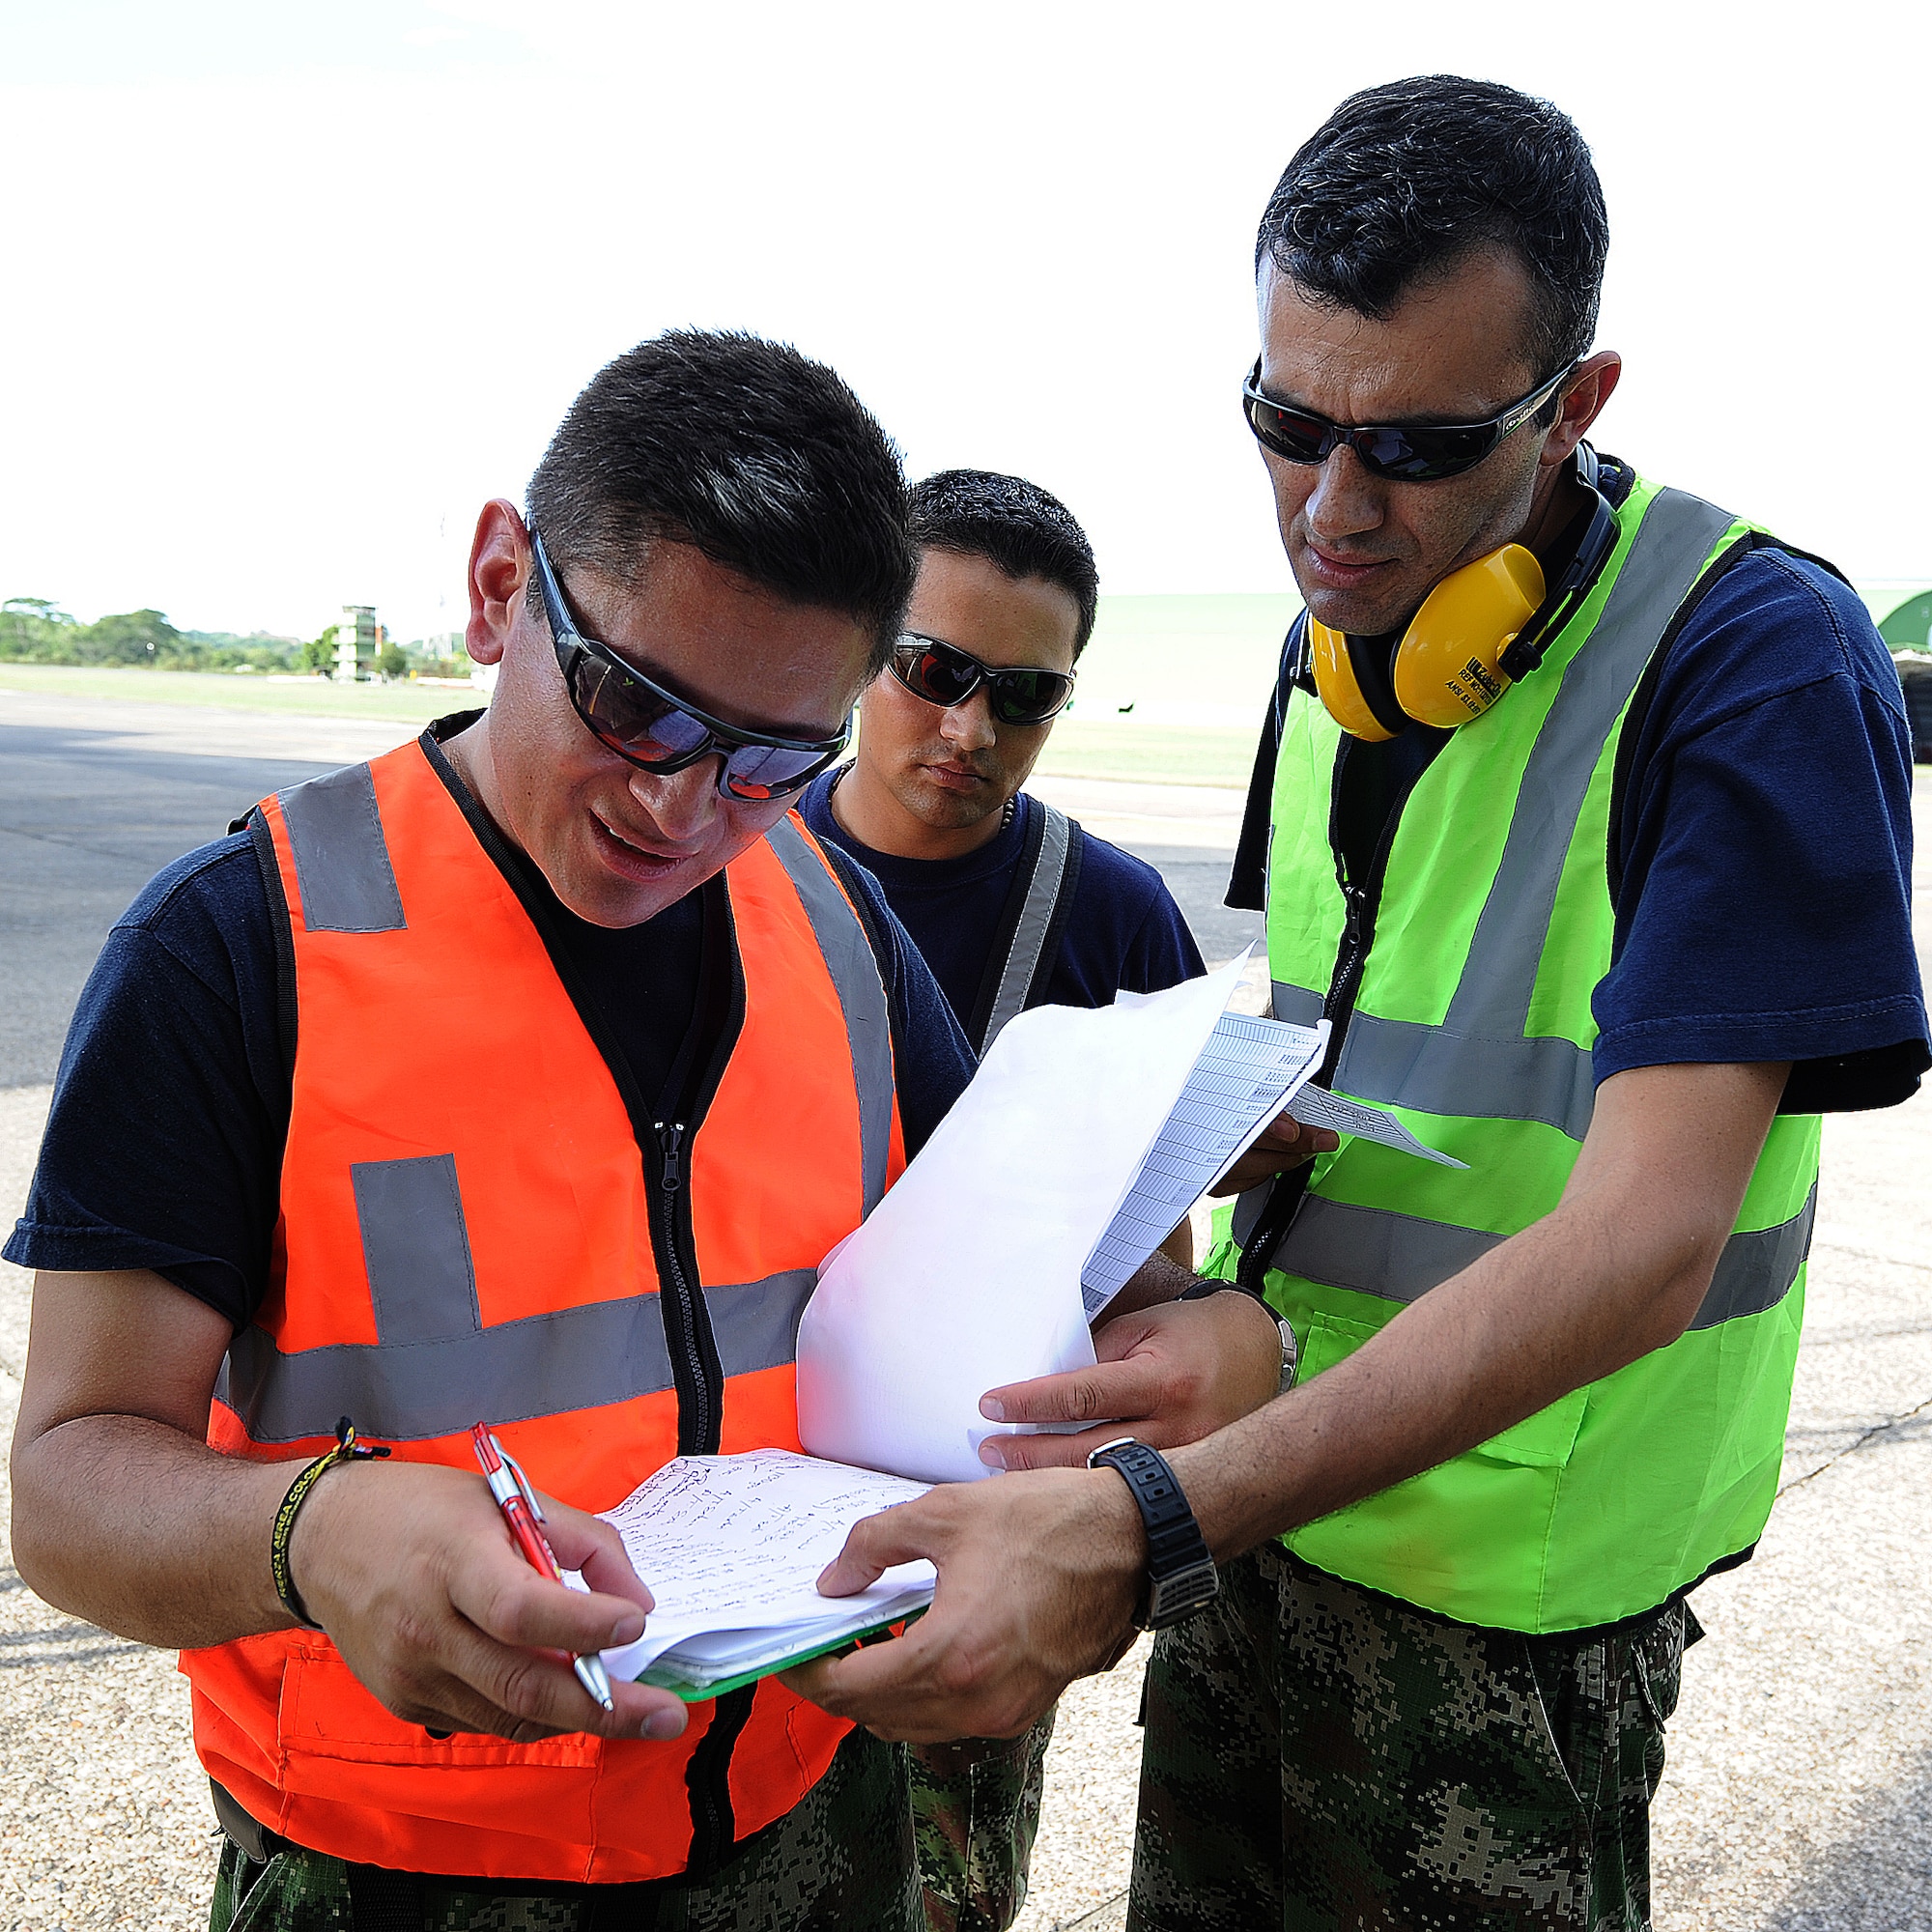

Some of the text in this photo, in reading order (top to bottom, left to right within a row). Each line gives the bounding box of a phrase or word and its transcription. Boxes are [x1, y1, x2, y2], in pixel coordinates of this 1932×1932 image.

[1458, 668, 1474, 682] REF
[1445, 680, 1465, 696] ANSI
[273, 1504, 293, 1549] AEREA
